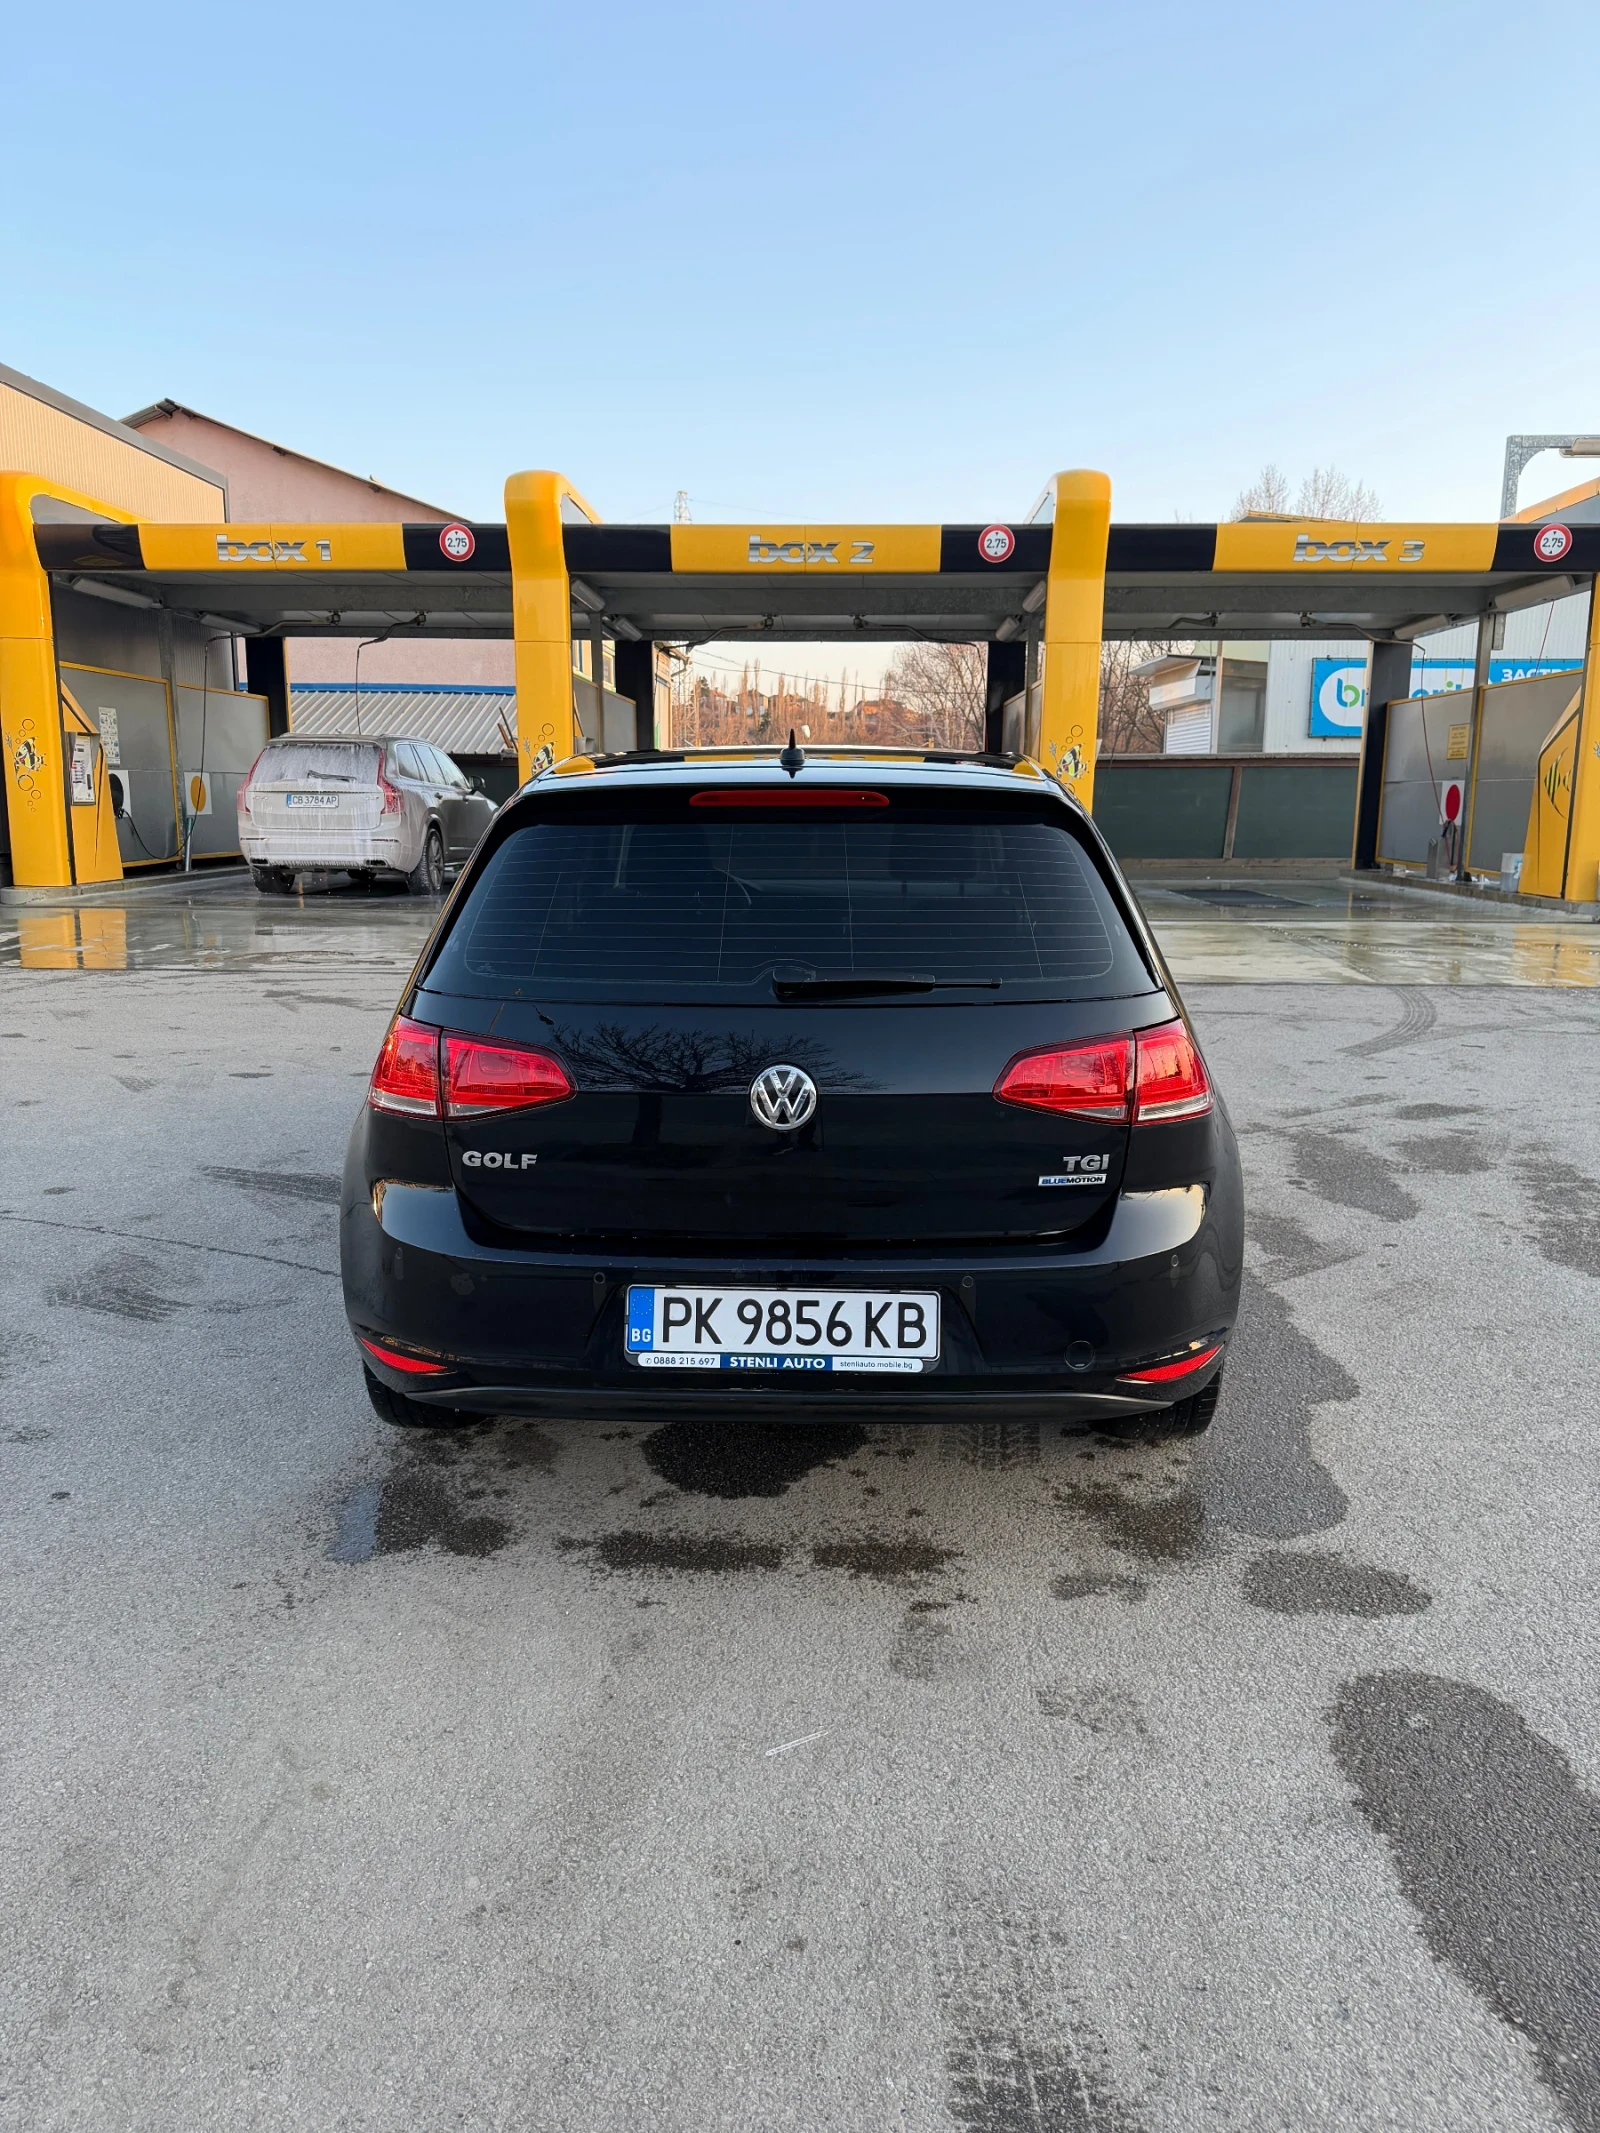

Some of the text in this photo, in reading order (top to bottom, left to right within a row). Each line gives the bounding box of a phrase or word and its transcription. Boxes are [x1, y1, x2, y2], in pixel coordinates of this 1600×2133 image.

[216, 534, 332, 562] box 1
[447, 537, 467, 548] 2.75
[748, 534, 875, 564] box 2
[986, 538, 1007, 549] 2.75
[1292, 533, 1425, 562] box 3
[1542, 537, 1564, 549] 2.75
[462, 1150, 538, 1169] GOLF
[1063, 1153, 1110, 1172] TGI
[1041, 1176, 1104, 1185] BLUEMOTION
[662, 1296, 927, 1350] PK 9856 KB
[631, 1329, 652, 1343] BG
[653, 1356, 715, 1366] 0888 215 697
[730, 1356, 826, 1369] STENLI AUTO
[840, 1360, 913, 1370] stenliauto.mobile.bg
